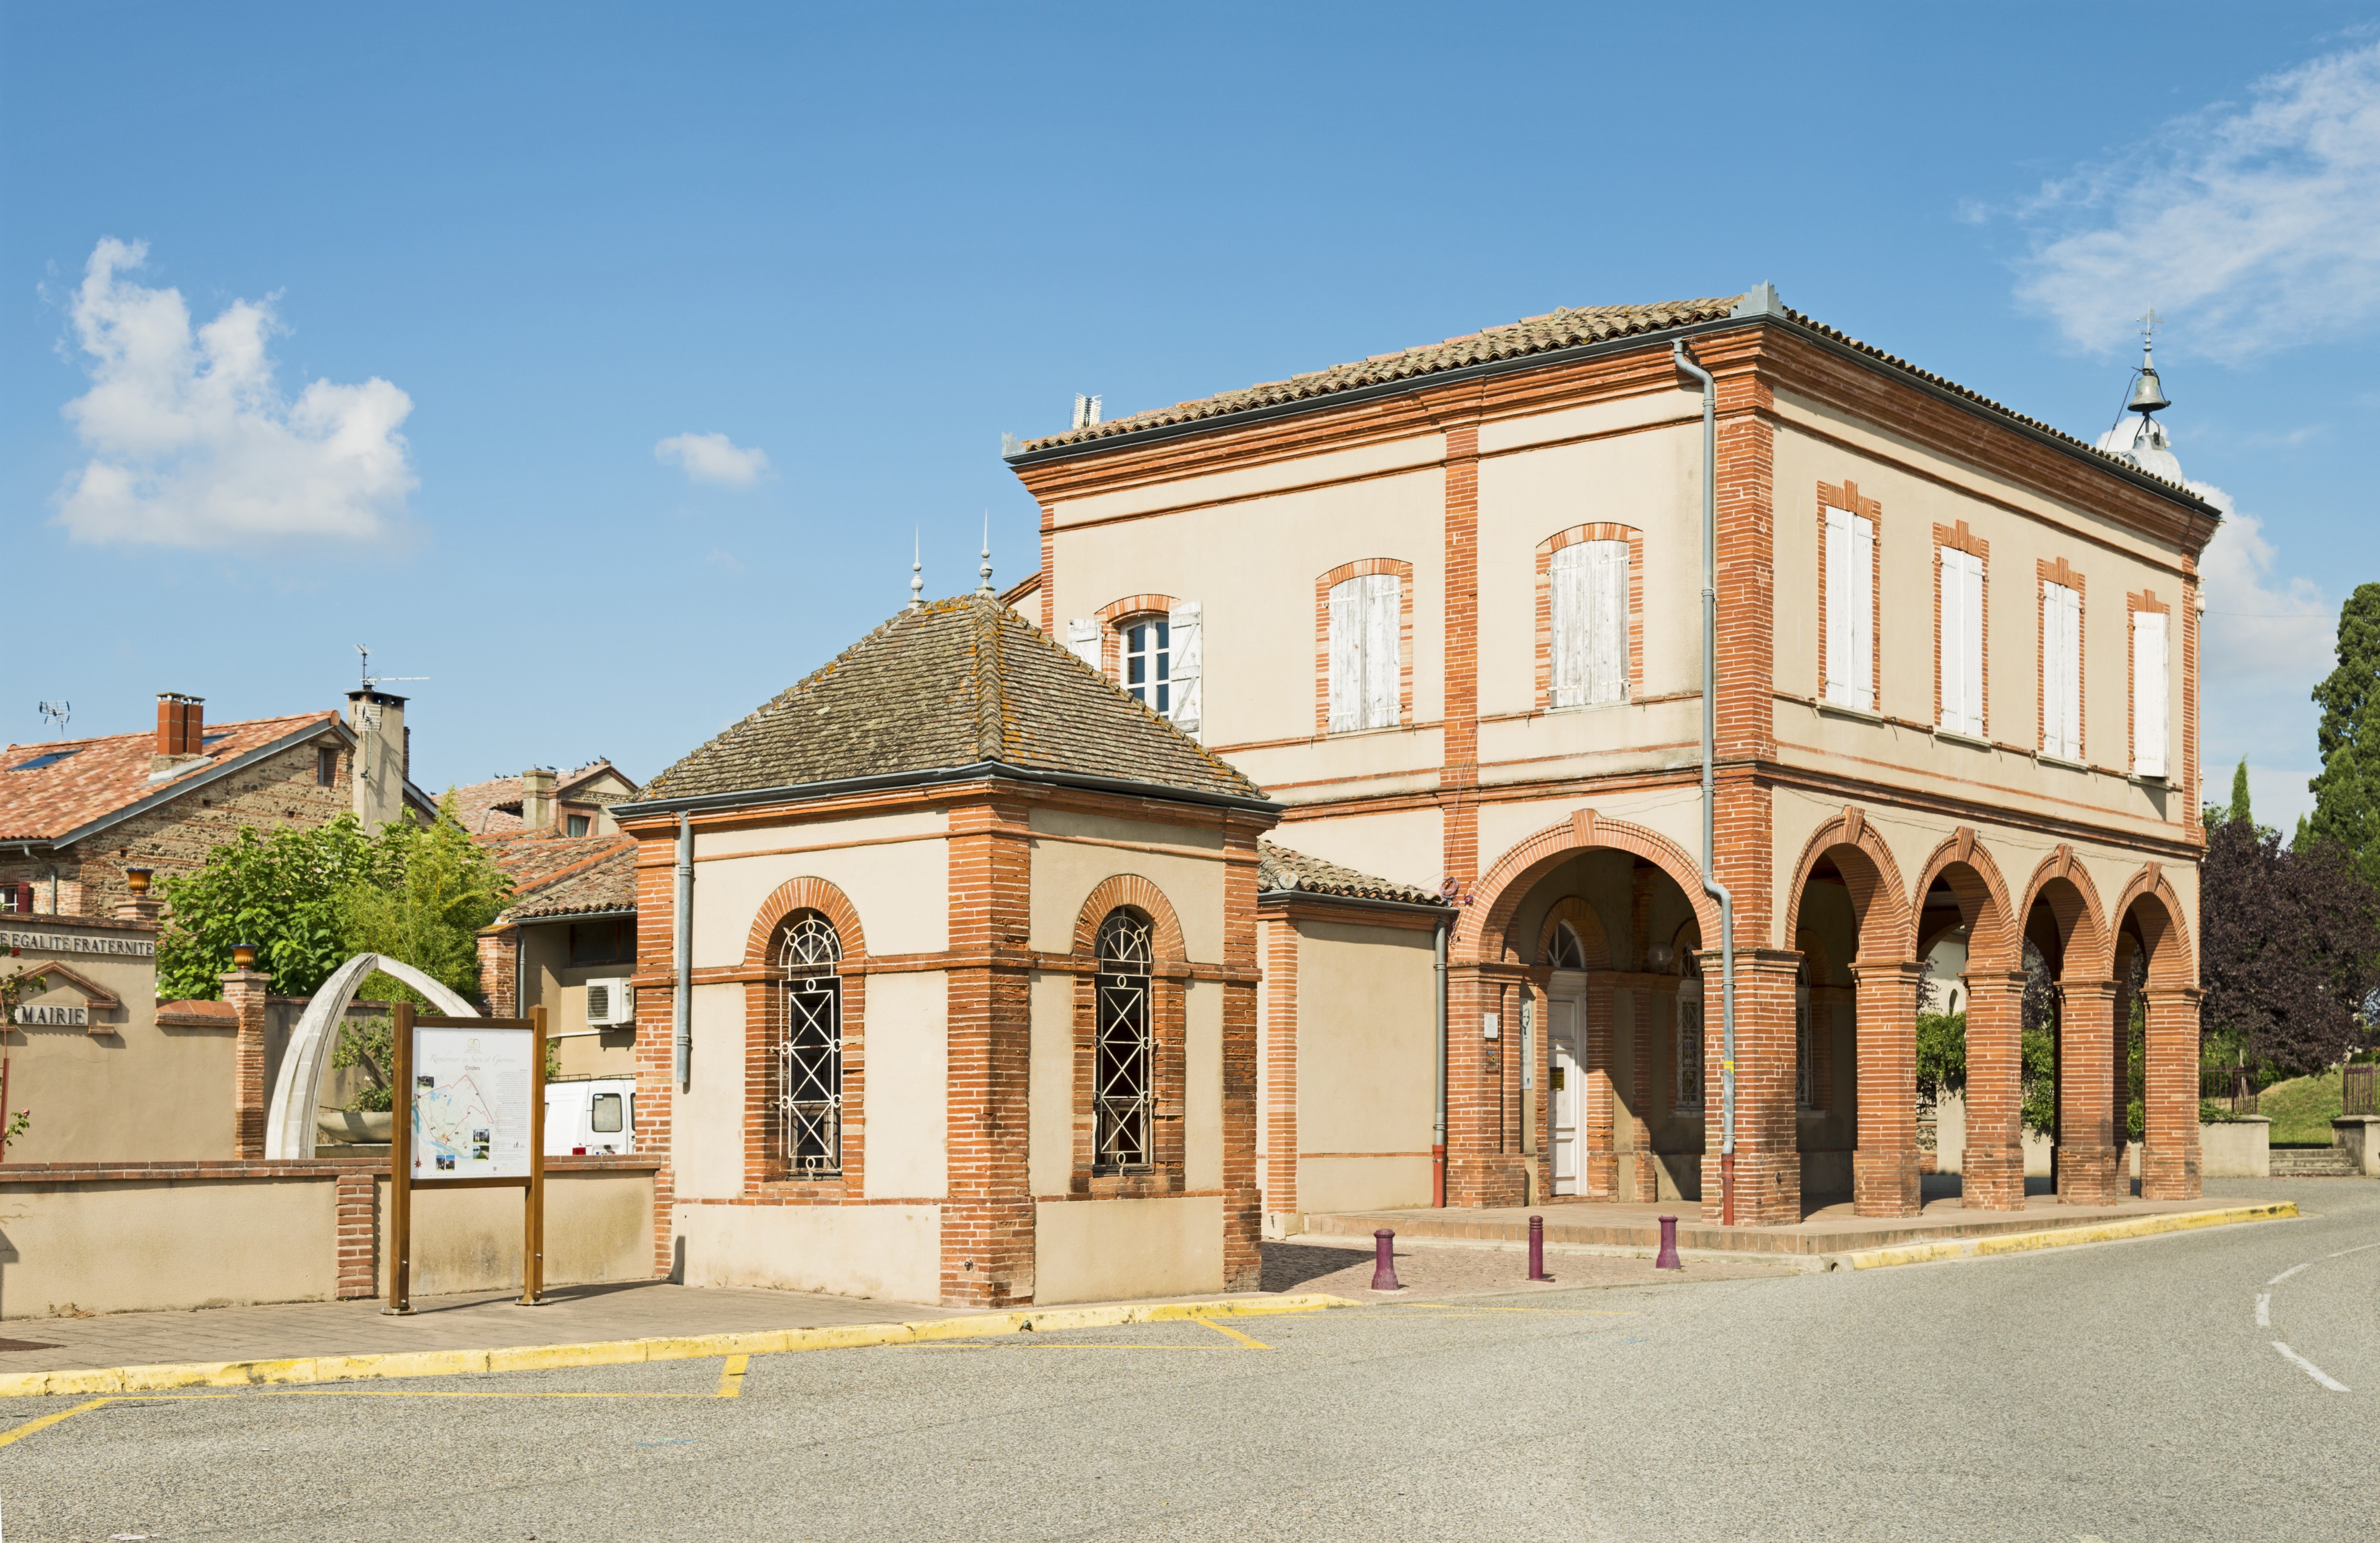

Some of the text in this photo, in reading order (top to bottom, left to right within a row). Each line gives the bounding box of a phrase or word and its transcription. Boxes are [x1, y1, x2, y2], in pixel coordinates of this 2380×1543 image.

[11, 934, 70, 950] EGALITE
[74, 938, 153, 955] FRATERNITE
[21, 1006, 84, 1025] MAIRIE
[430, 1051, 460, 1064] Randonner
